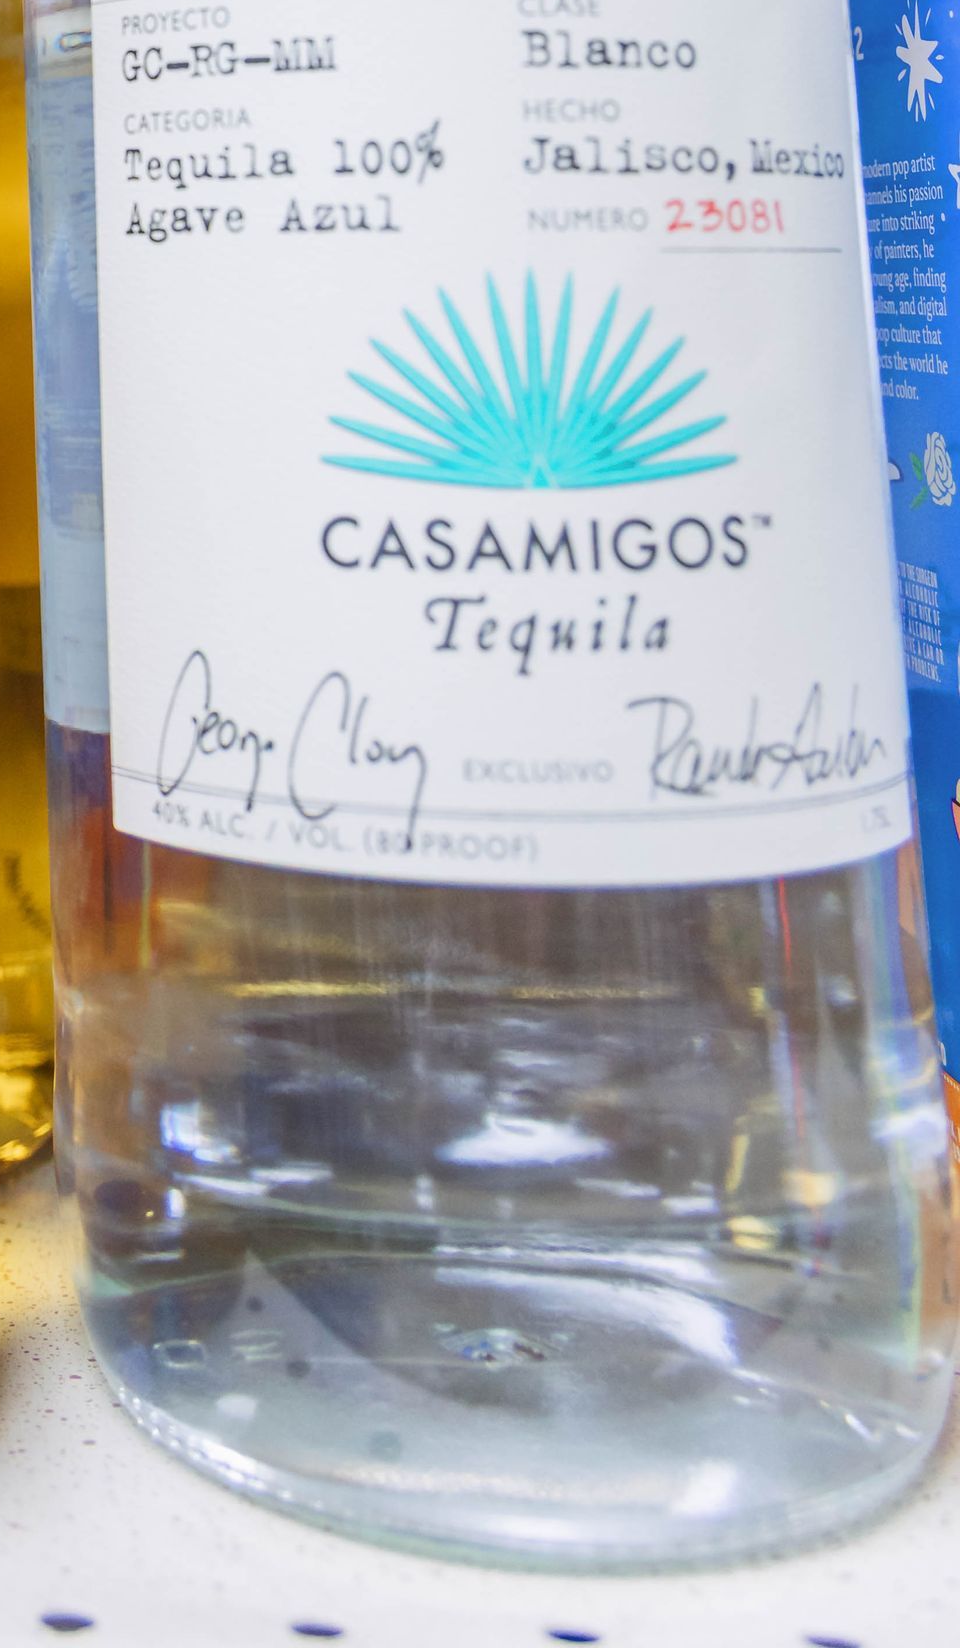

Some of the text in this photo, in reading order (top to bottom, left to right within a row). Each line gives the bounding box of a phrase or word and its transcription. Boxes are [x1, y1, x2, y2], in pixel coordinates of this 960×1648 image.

[121, 6, 231, 36] PROYECTO
[121, 35, 338, 82] GC-RG-MM
[521, 29, 698, 70] Blanco
[124, 108, 251, 135] CATEGORIA
[522, 99, 621, 122] HECHO
[125, 119, 445, 189] Tequila 100%
[523, 136, 844, 180] Jalisco, Mexico
[893, 161, 909, 181] pop
[911, 153, 935, 173] artist
[894, 185, 906, 203] his
[909, 181, 943, 208] passion
[125, 195, 402, 243] Agave Azul
[527, 198, 785, 233] NUMERO 23081
[882, 213, 899, 231] into
[900, 211, 935, 235] striking
[874, 240, 883, 259] of
[884, 241, 921, 264] painters,
[922, 238, 935, 258] he
[895, 273, 912, 292] age,
[913, 268, 946, 293] finding
[899, 296, 916, 315] and
[917, 296, 947, 322] digital
[891, 323, 921, 344] culture
[922, 325, 942, 345] that
[894, 352, 908, 371] the
[909, 353, 934, 374] world
[936, 354, 949, 375] he
[896, 379, 919, 400] color.
[425, 595, 672, 676] Tequila
[463, 758, 613, 784] EXCLUSIVO
[151, 800, 190, 828] 40%
